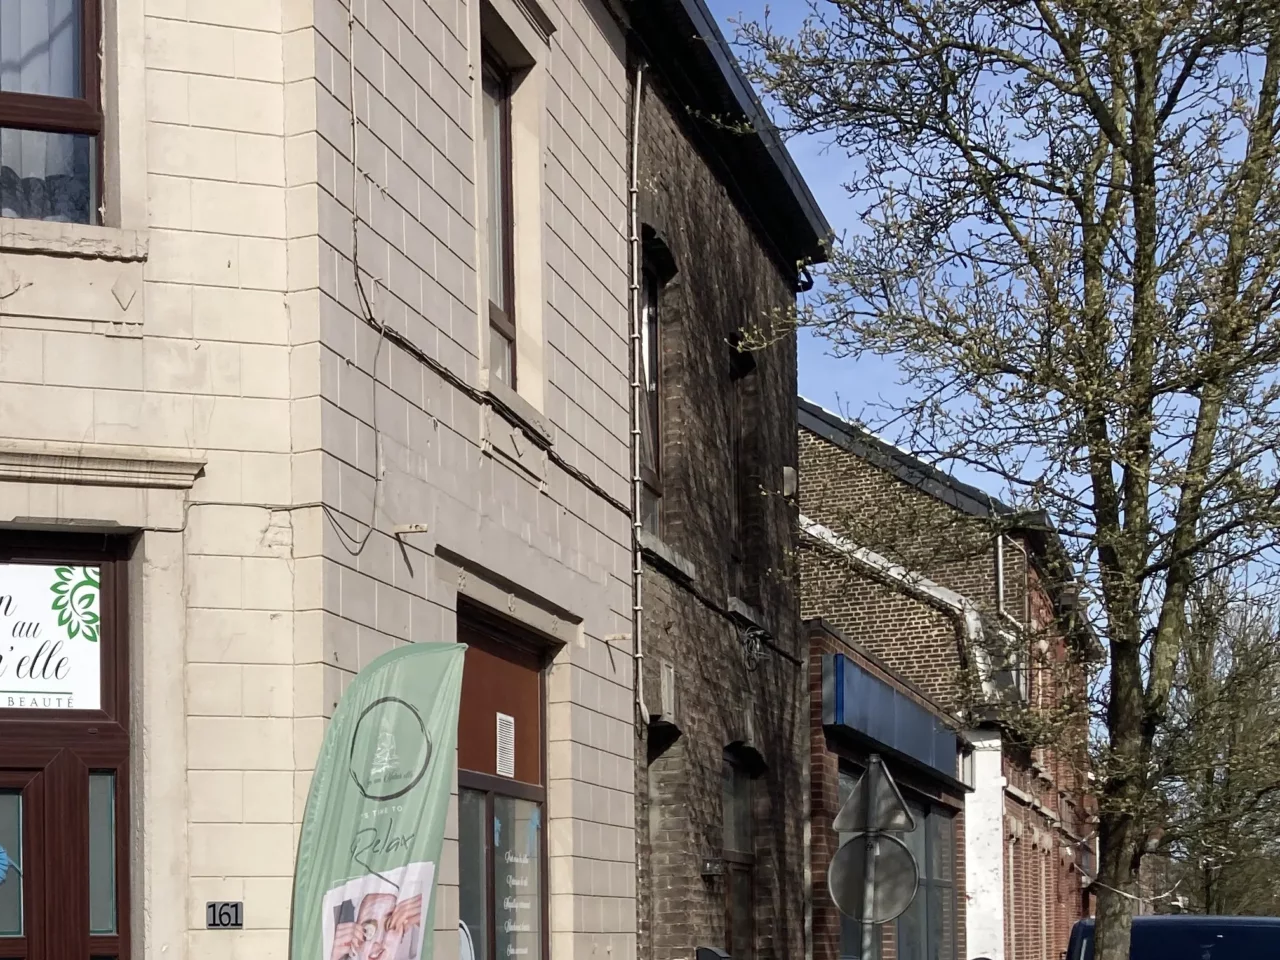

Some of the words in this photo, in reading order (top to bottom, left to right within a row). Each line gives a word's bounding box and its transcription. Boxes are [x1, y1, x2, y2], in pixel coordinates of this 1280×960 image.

[12, 620, 42, 638] au
[7, 696, 75, 708] BEAUTÉ
[351, 817, 415, 880] Relax
[207, 902, 243, 927] 161
